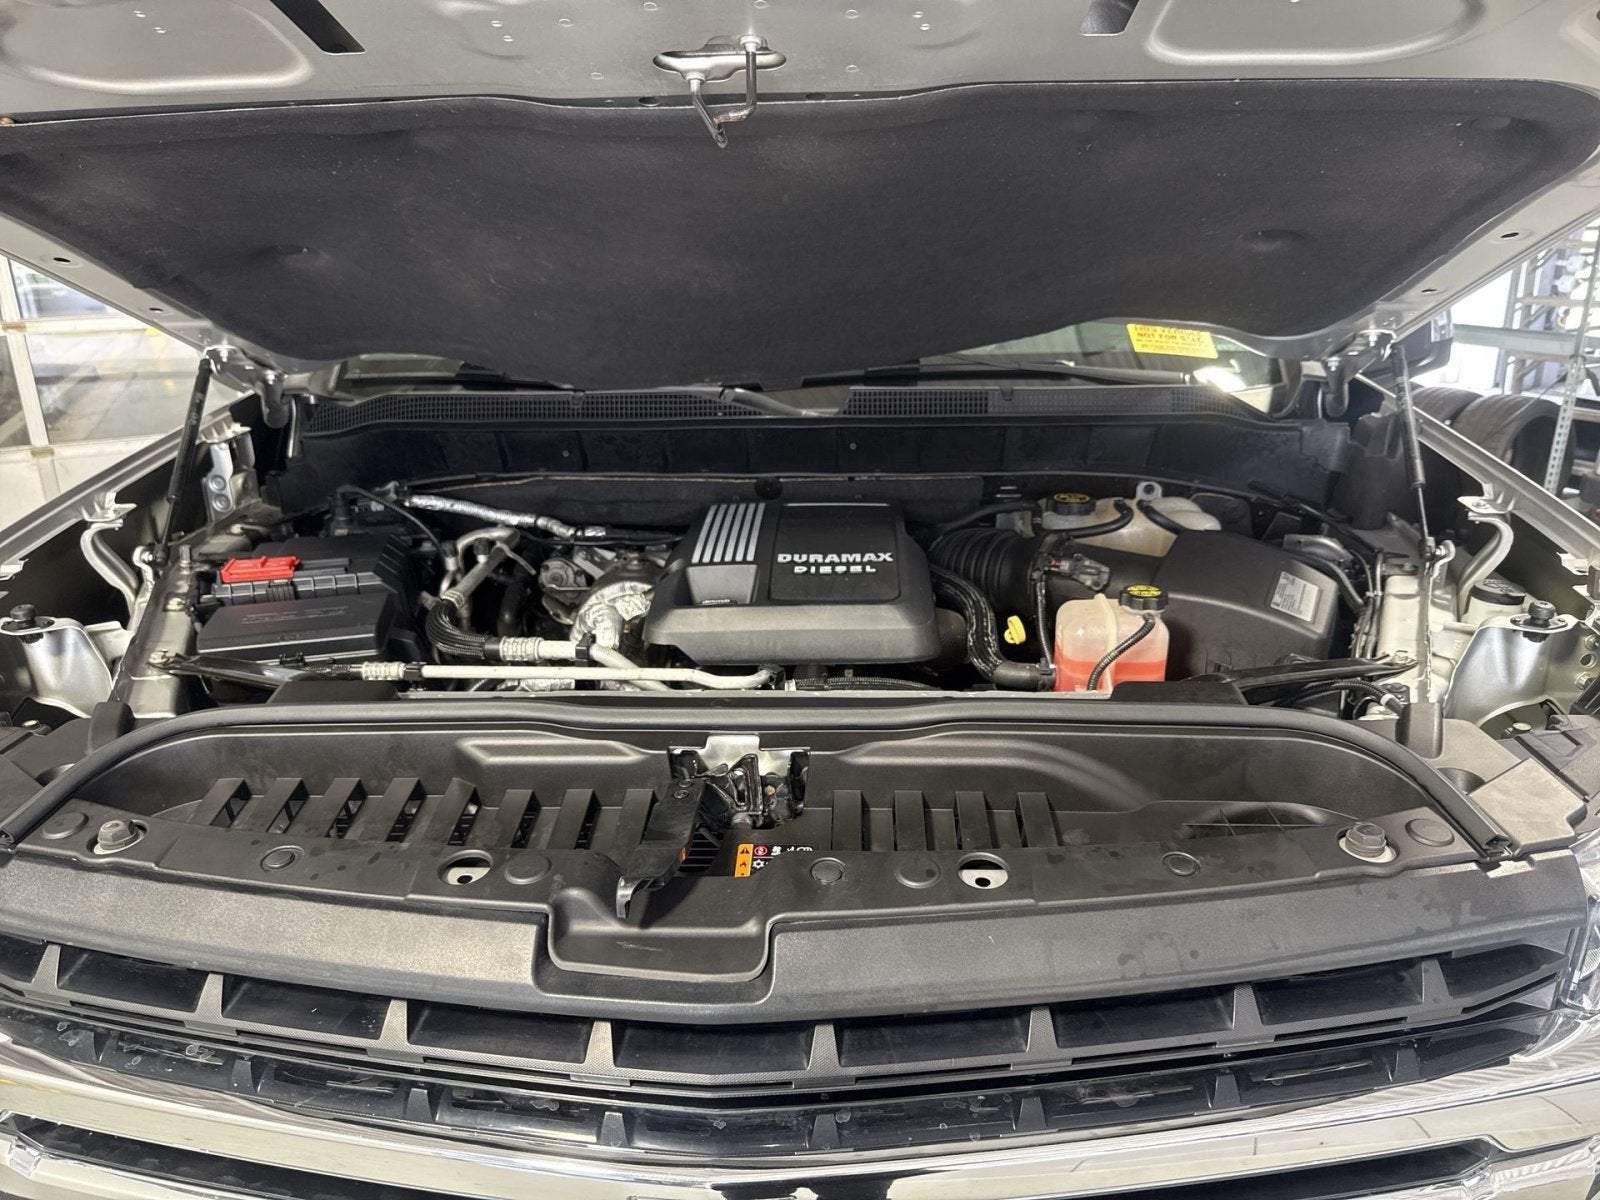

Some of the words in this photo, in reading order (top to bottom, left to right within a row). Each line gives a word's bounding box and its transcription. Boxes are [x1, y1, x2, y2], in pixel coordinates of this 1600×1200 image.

[1158, 333, 1177, 341] FOR
[777, 552, 894, 563] DURAMAX
[793, 565, 876, 574] DIESEL
